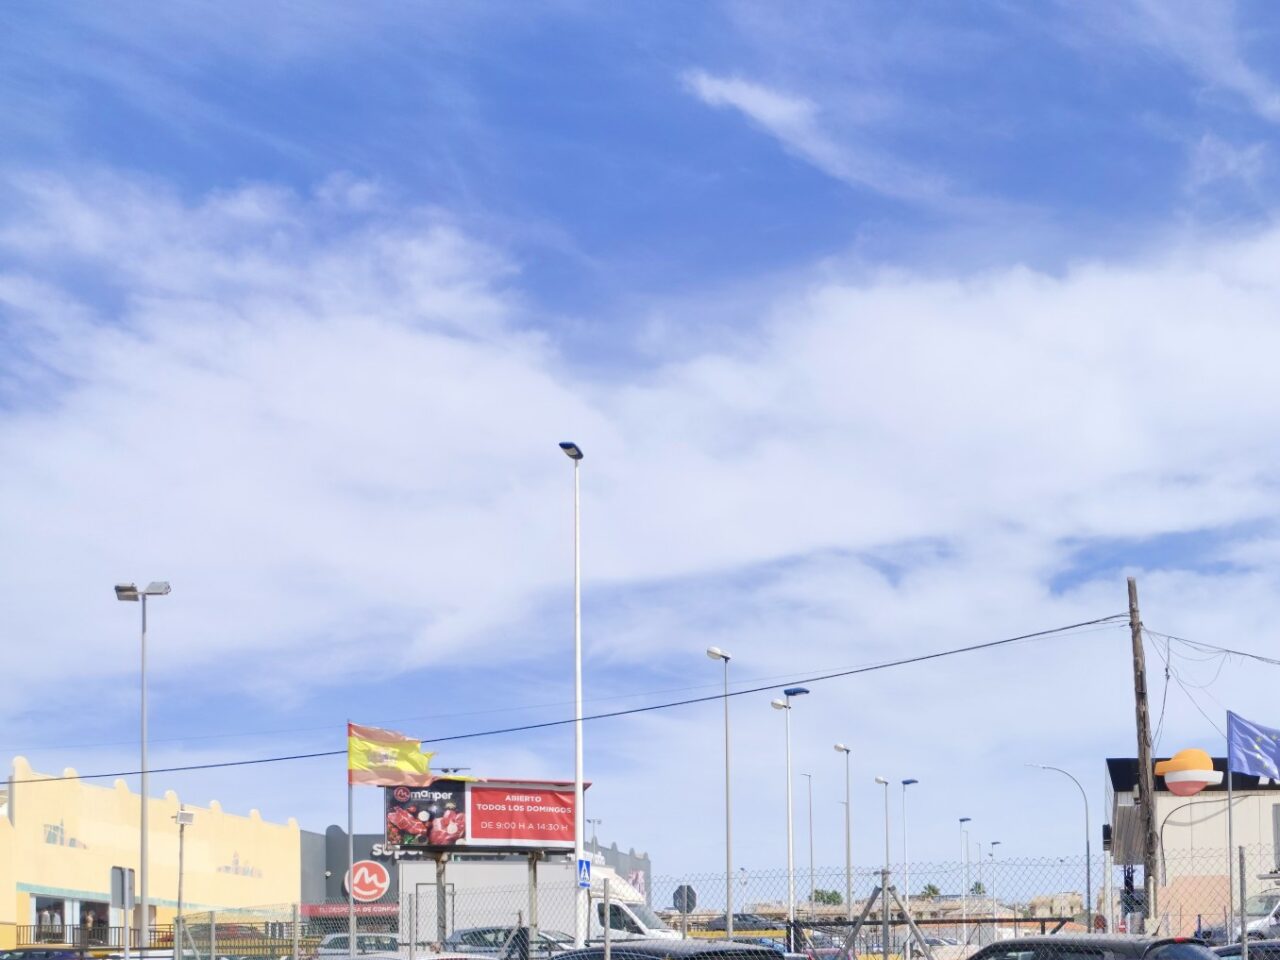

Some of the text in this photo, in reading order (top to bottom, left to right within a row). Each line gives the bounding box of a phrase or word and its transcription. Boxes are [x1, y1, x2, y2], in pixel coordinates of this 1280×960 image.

[410, 790, 453, 802] manper
[505, 795, 542, 803] ABIERTO
[477, 803, 572, 814] TODOS LOS DOMINGOS
[480, 822, 494, 830] DE
[496, 822, 516, 830] 9:00
[536, 824, 560, 832] 14:30
